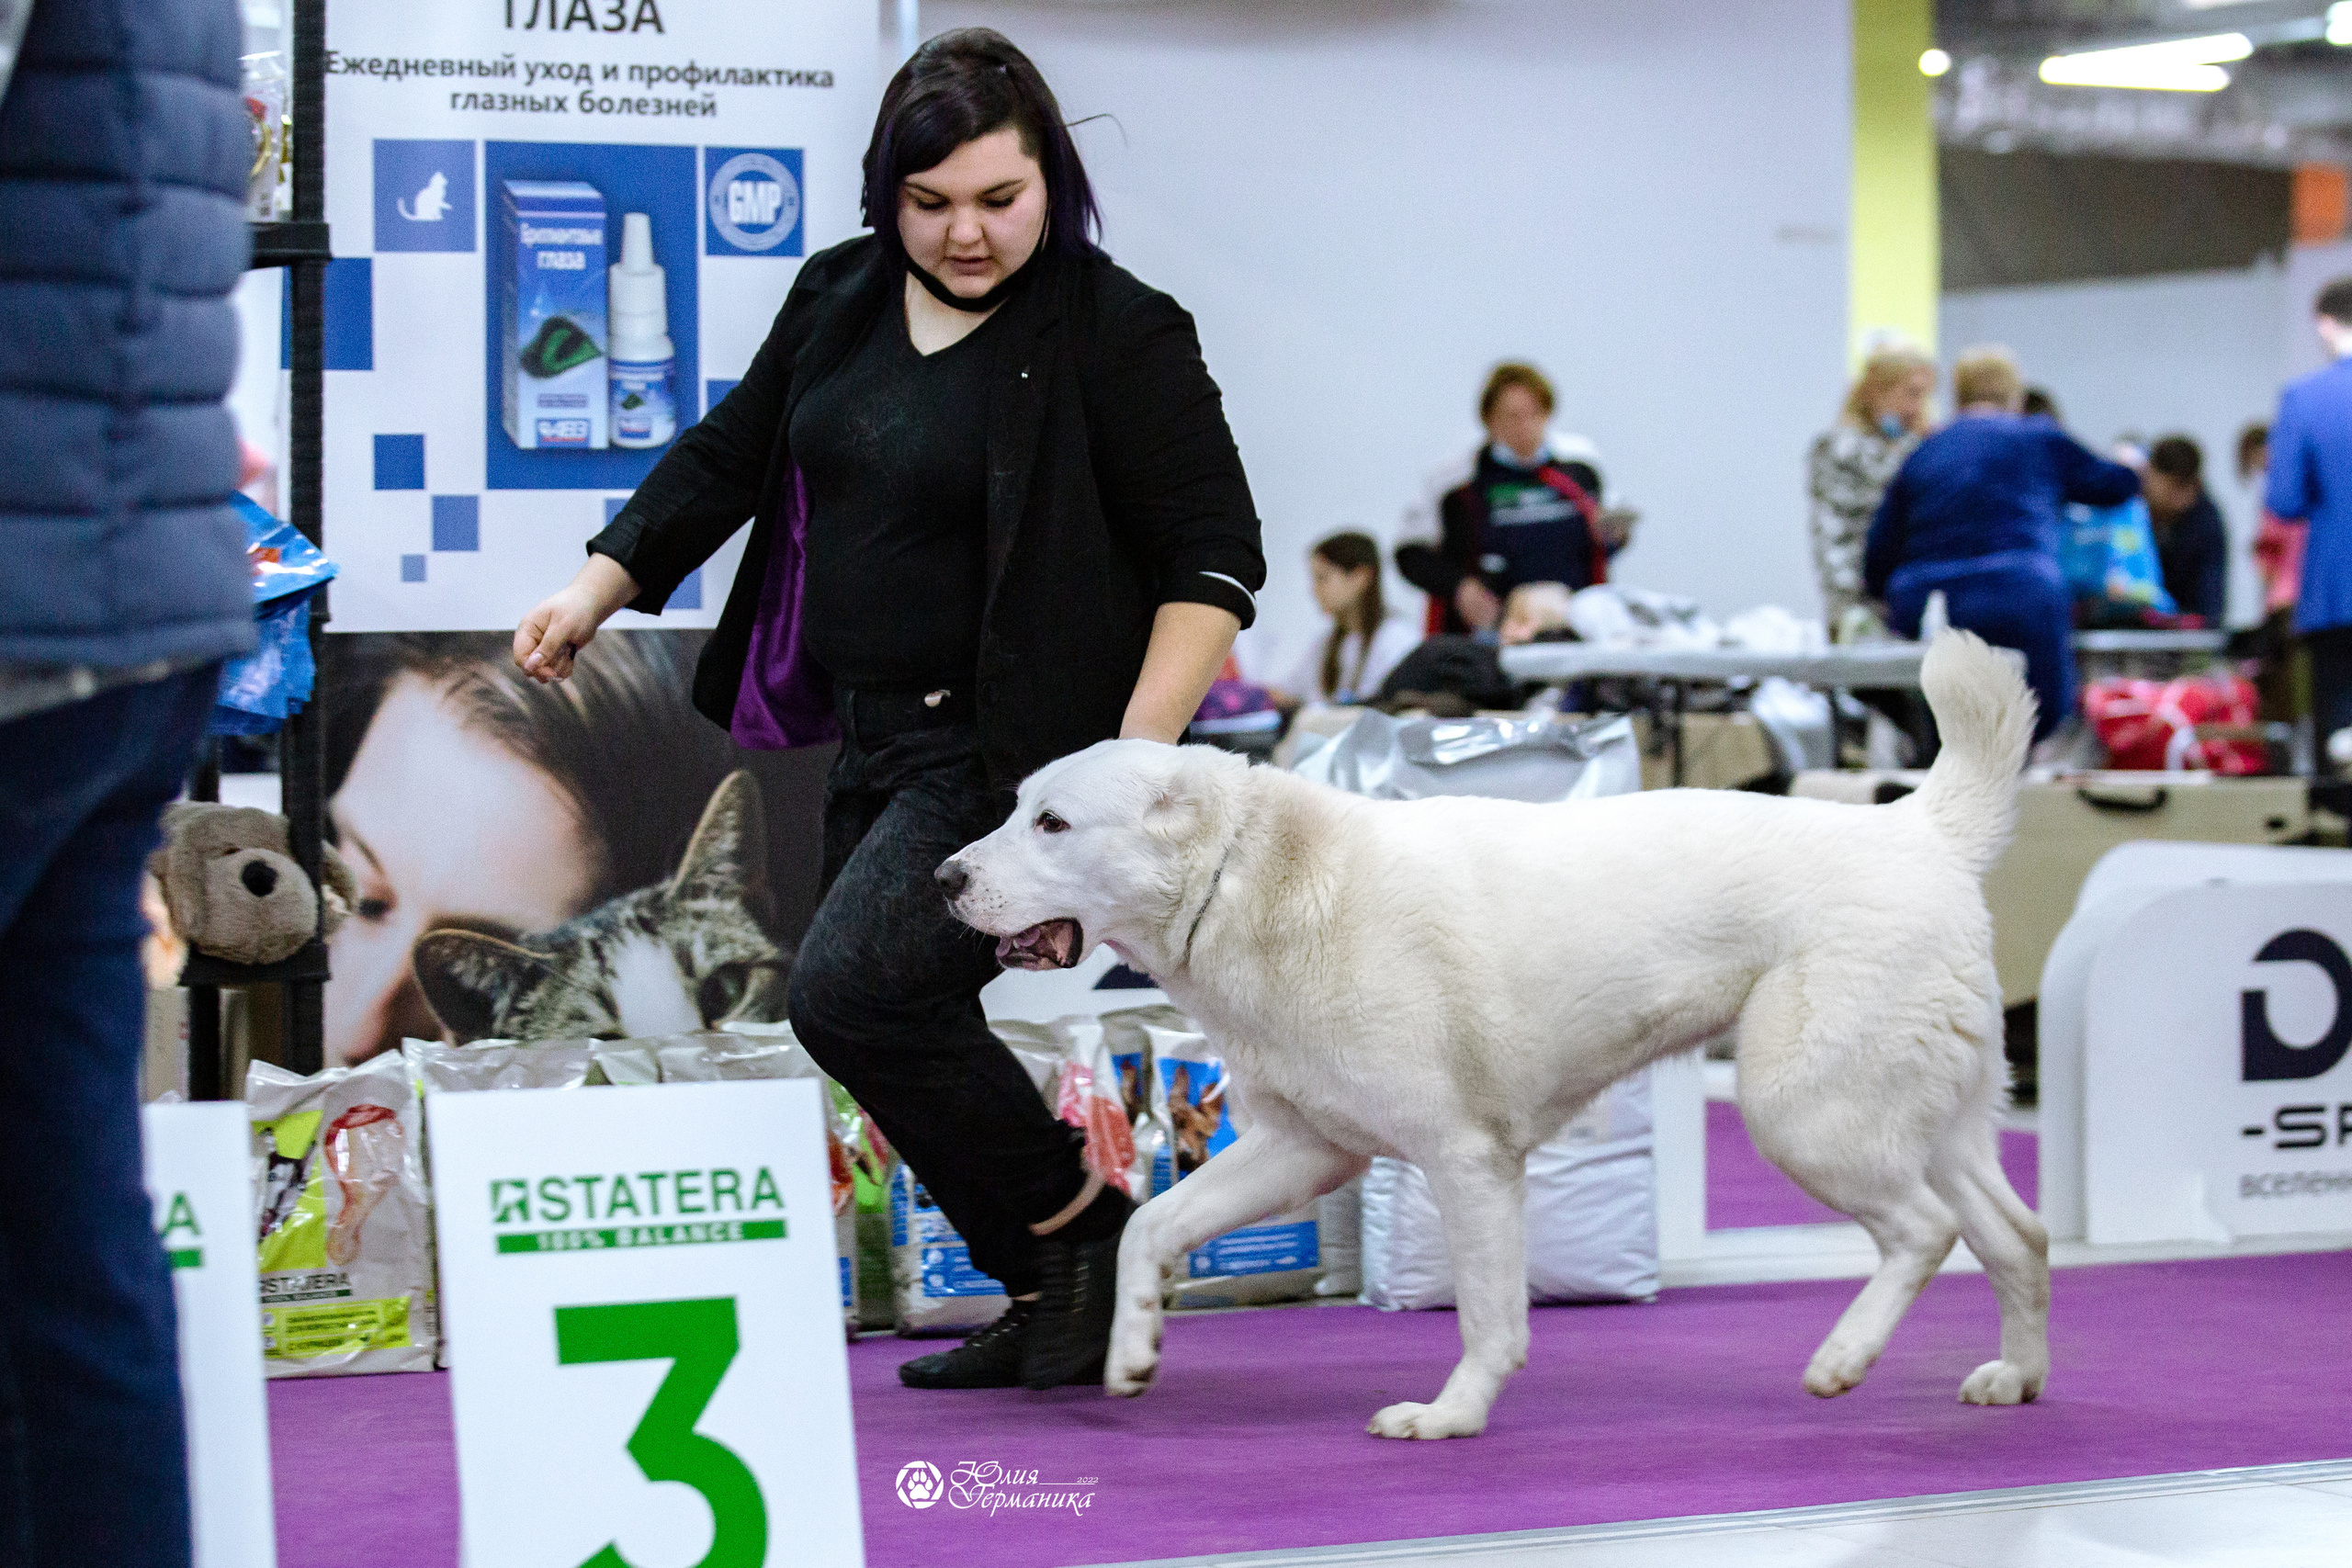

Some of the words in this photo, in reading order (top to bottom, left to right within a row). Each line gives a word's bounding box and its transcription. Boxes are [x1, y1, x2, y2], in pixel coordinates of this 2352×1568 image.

[503, 0, 665, 34] ГЛАЗА
[324, 51, 517, 82] Ежедневный
[525, 61, 594, 86] уход
[602, 63, 620, 82] и
[628, 59, 835, 90] профилактика
[450, 92, 569, 114] глазных
[578, 89, 717, 117] болезней
[729, 180, 781, 222] GMP
[2241, 1103, 2352, 1148] -S
[537, 1166, 786, 1223] STATERA
[553, 1295, 770, 1568] 3
